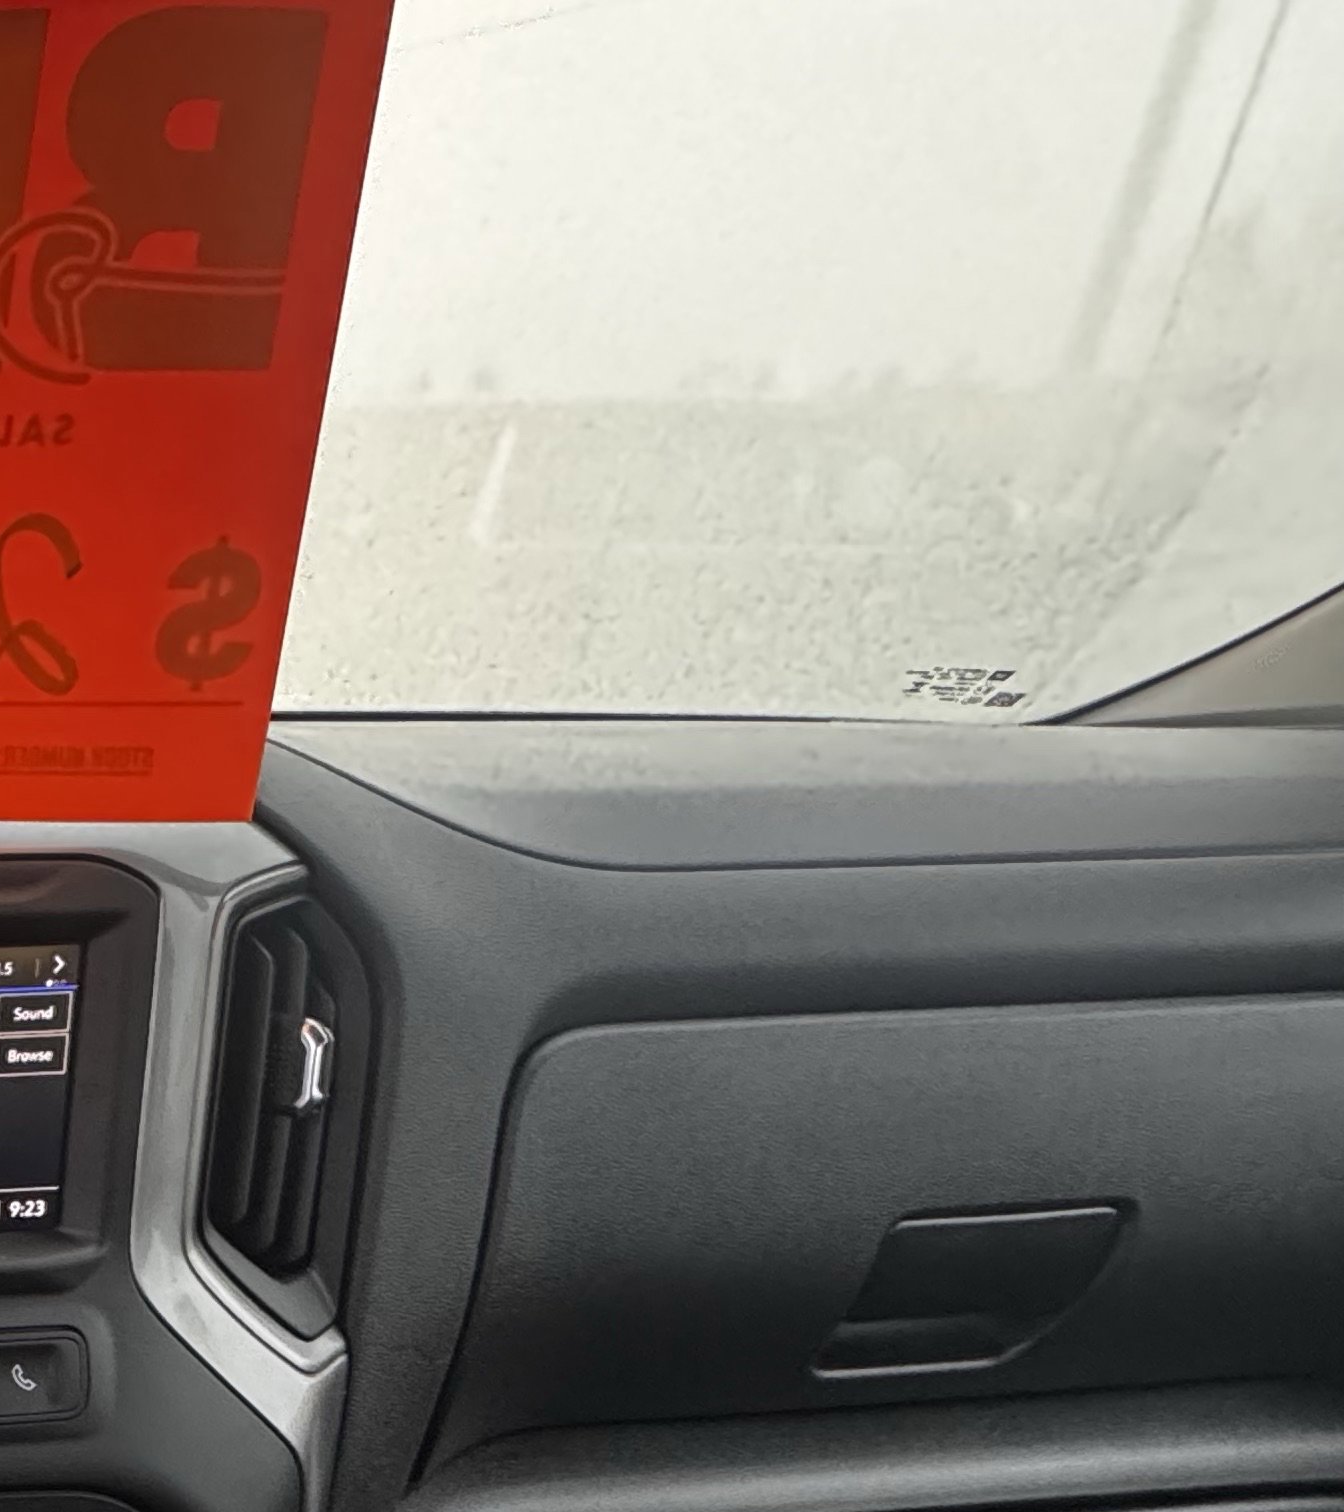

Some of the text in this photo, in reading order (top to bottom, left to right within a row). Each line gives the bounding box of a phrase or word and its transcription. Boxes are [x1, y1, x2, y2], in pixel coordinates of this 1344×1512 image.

[13, 1005, 54, 1021] Sound
[7, 1050, 54, 1064] Browse
[9, 1199, 47, 1218] 9:23
